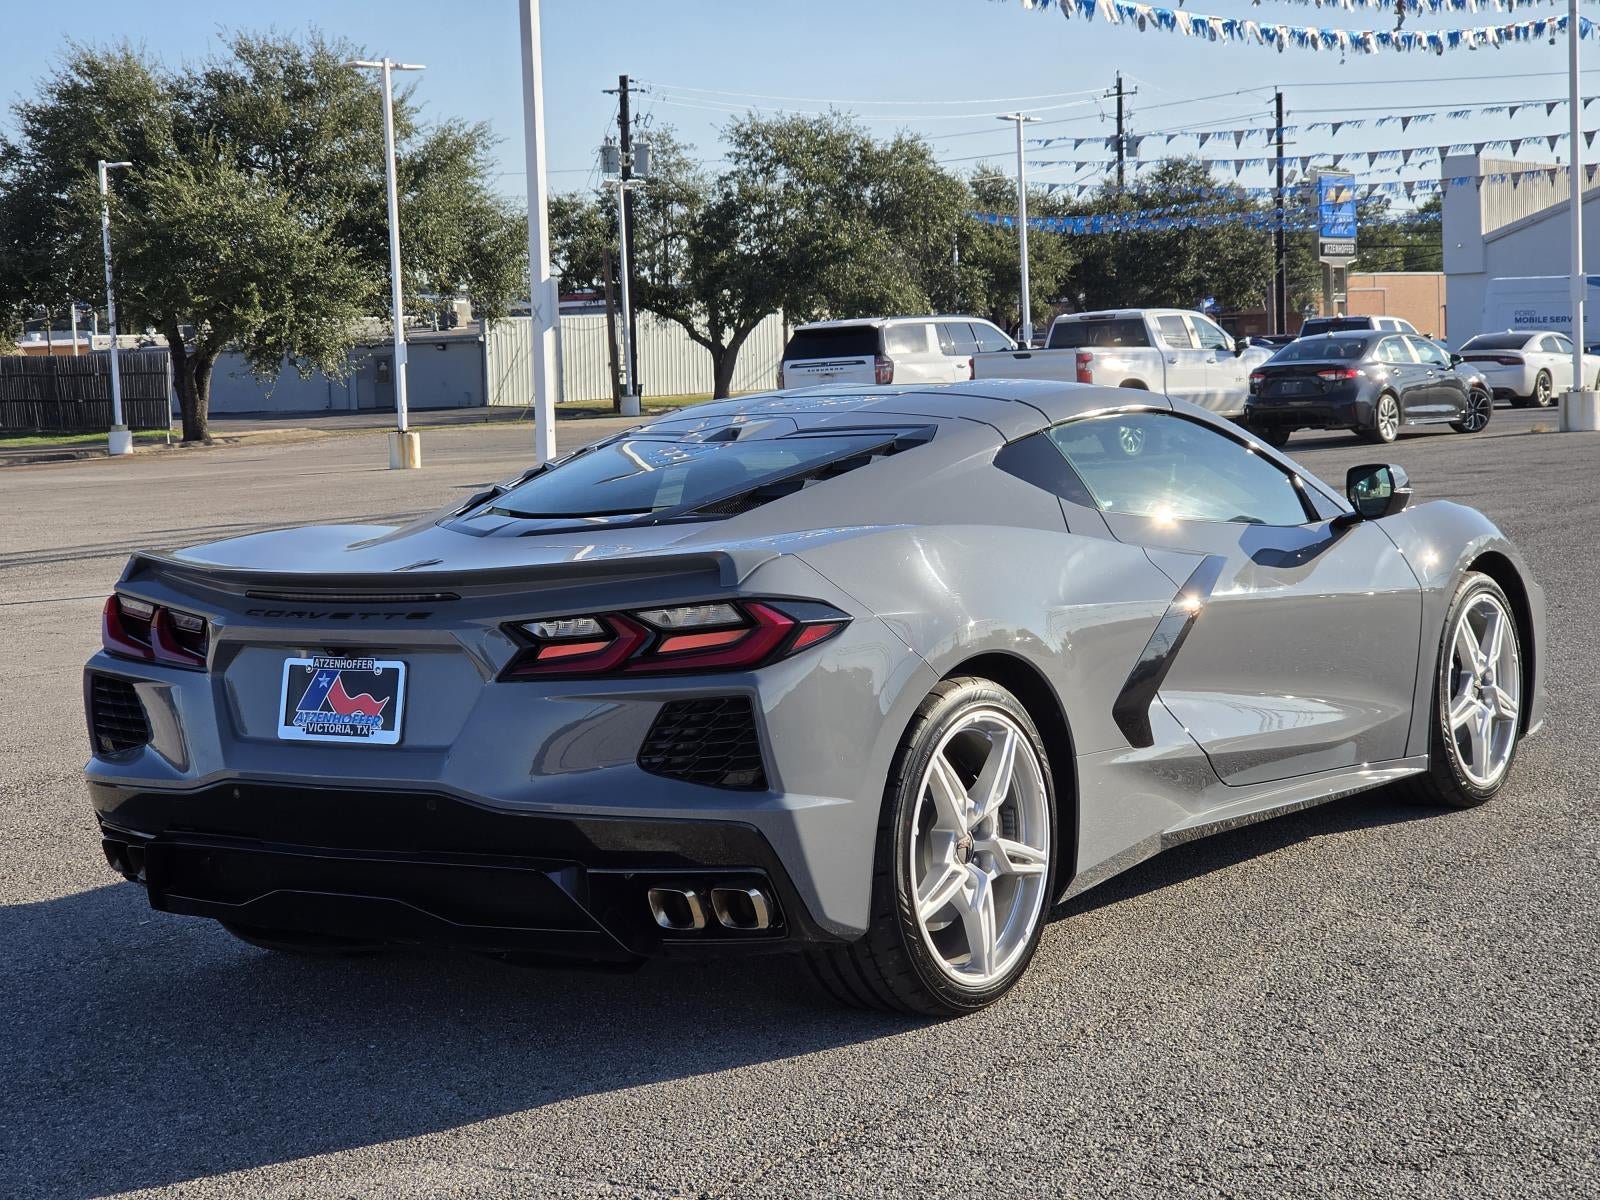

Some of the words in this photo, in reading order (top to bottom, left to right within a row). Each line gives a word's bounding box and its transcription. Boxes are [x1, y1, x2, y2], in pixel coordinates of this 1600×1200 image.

[1514, 316, 1548, 324] MOBILE
[1549, 315, 1588, 323] SERVE
[245, 608, 433, 620] CORVETTE
[313, 658, 374, 669] ATZENHOFFER
[296, 711, 381, 727] ATZENHOFFER
[308, 723, 354, 735] VICTORIA,
[356, 725, 369, 735] TX
